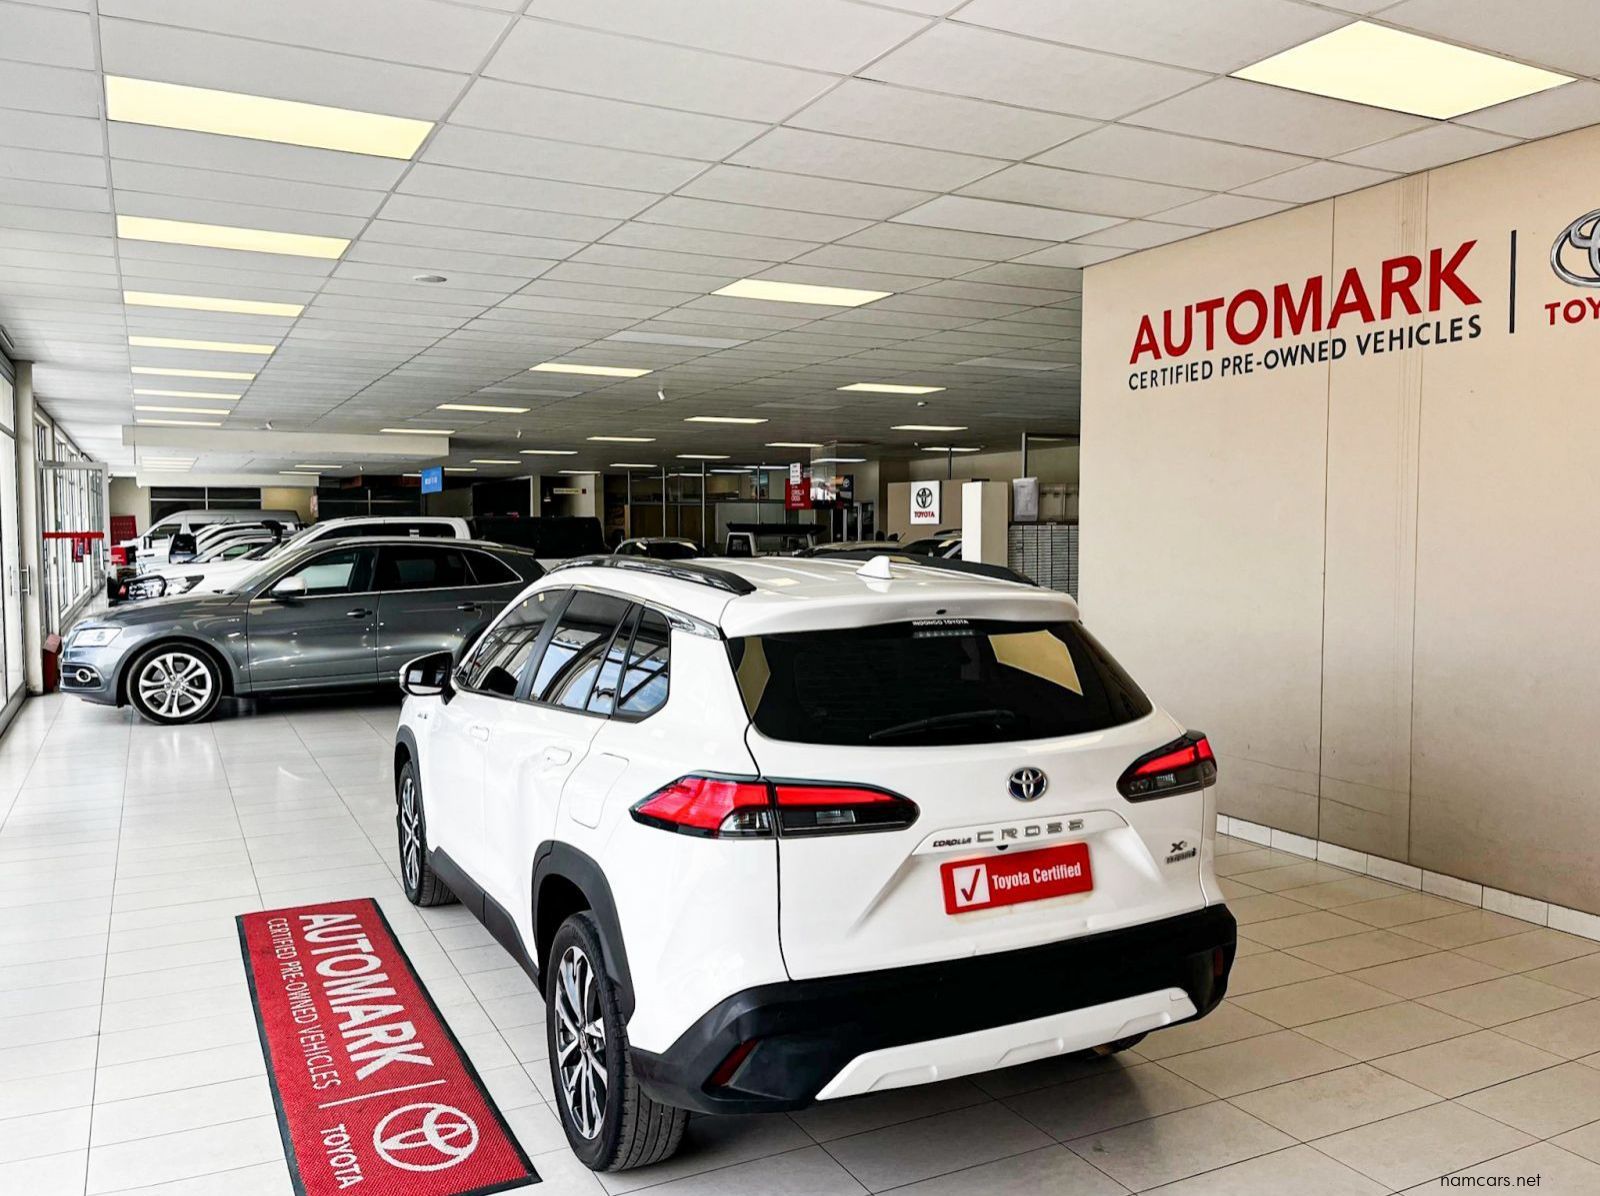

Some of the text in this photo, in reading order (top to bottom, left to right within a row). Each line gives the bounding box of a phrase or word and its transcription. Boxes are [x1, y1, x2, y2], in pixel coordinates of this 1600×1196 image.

[1129, 239, 1482, 365] AUTOMARK
[1128, 313, 1483, 391] CERTIFIED PRE-OWNED VEHICLES
[914, 511, 935, 519] TOYOTA
[933, 818, 1084, 848] COROLLA CROSS
[992, 861, 1082, 890] Toyota Certified
[266, 917, 343, 1092] CERTIFIED PRE-OWNED VEHICLES
[298, 913, 434, 1081] AUTOMARK
[320, 1122, 366, 1190] TOYOTA
